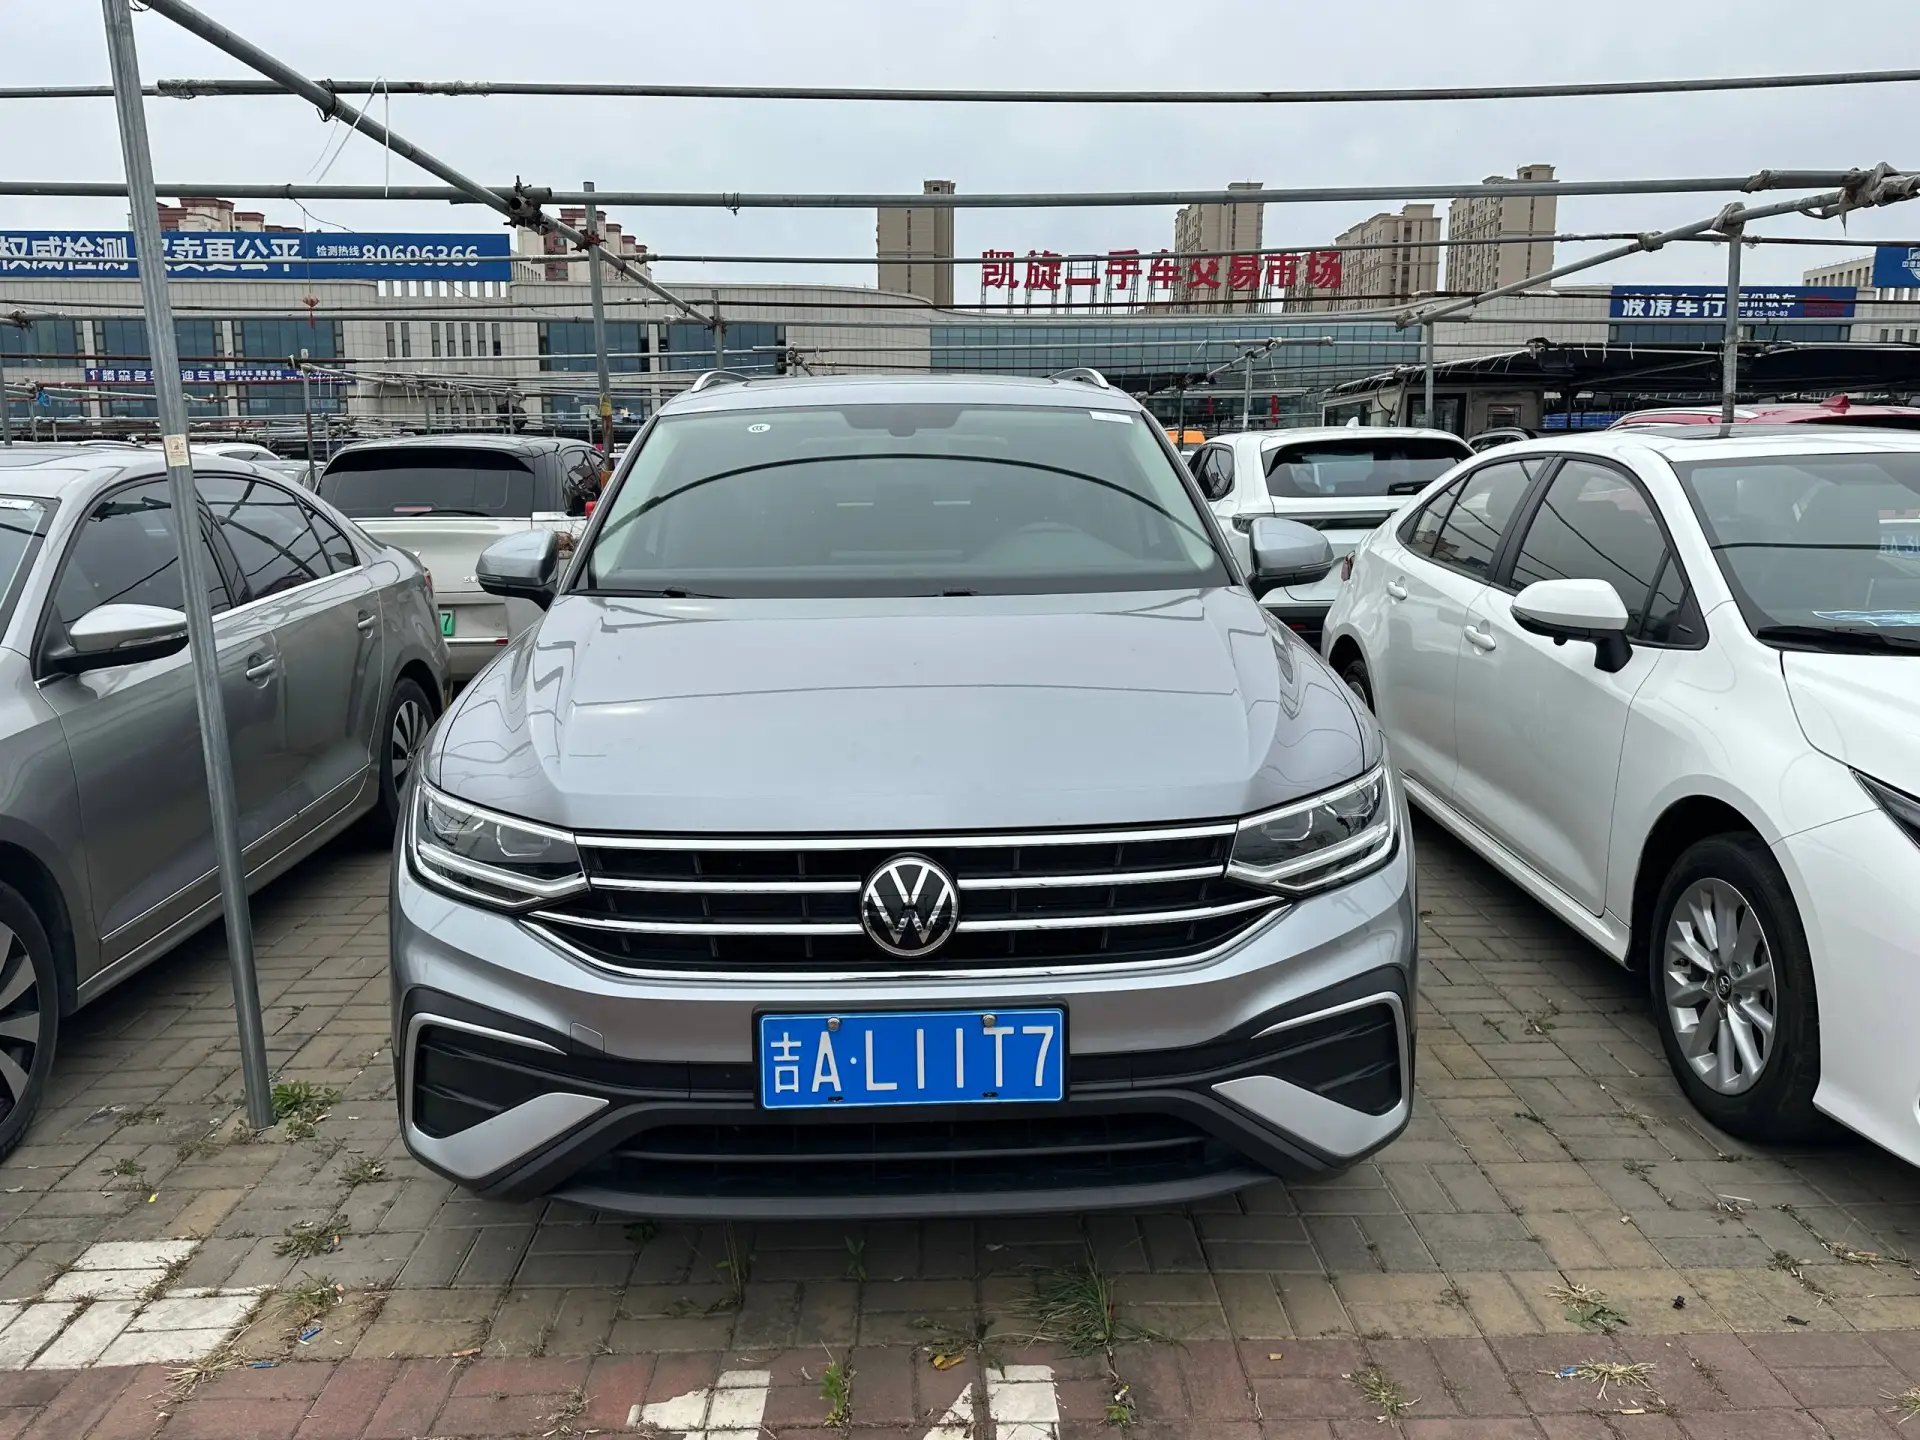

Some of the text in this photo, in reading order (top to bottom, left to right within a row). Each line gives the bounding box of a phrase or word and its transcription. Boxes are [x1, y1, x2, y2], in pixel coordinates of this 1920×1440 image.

[0, 236, 129, 271] 权威检测
[316, 244, 360, 257] 检测热线
[362, 244, 479, 267] 80606366
[981, 249, 1342, 290] 凯旋二手车交易市场
